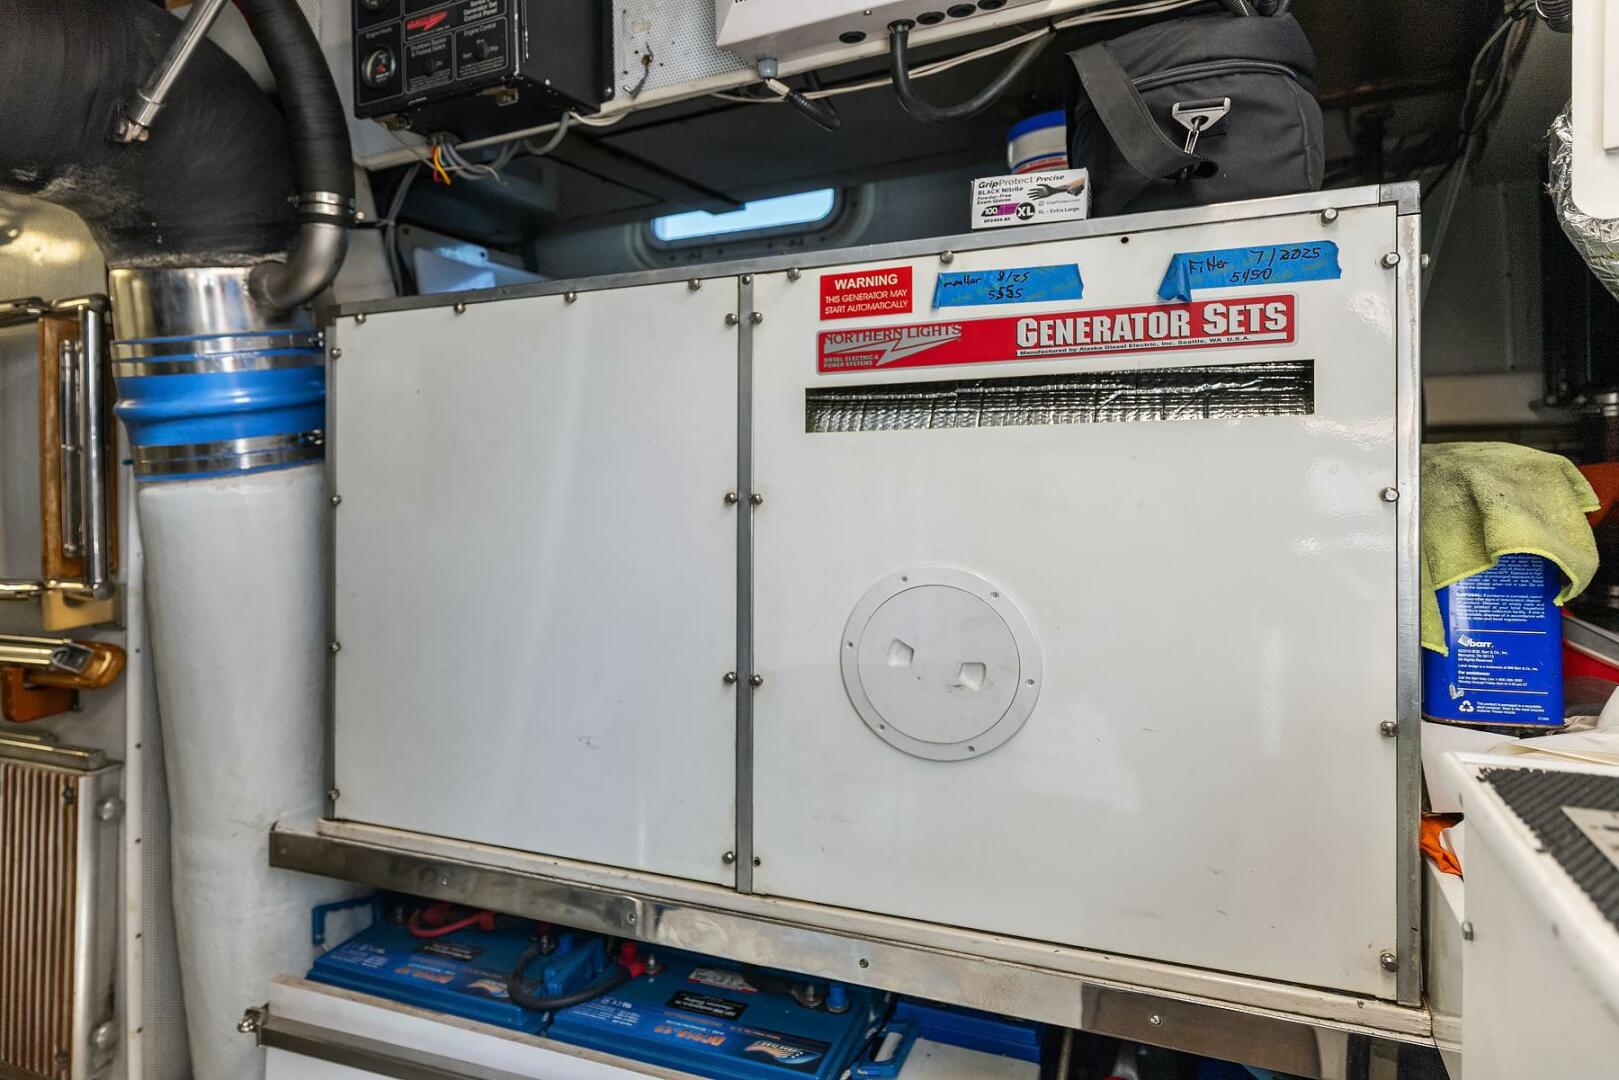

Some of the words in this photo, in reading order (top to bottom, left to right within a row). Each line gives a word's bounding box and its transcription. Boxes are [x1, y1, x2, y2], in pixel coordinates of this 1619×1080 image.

[1018, 206, 1034, 217] XL
[835, 274, 898, 290] WARNING
[842, 291, 888, 302] GENERATOR
[890, 289, 908, 297] MAY
[825, 305, 846, 314] START
[847, 300, 908, 312] AUTOMATICALLY
[1016, 309, 1190, 348] GENERATOR
[1202, 302, 1288, 335] SETS
[825, 328, 903, 345] NORTHERN
[906, 325, 962, 339] LIGHTS
